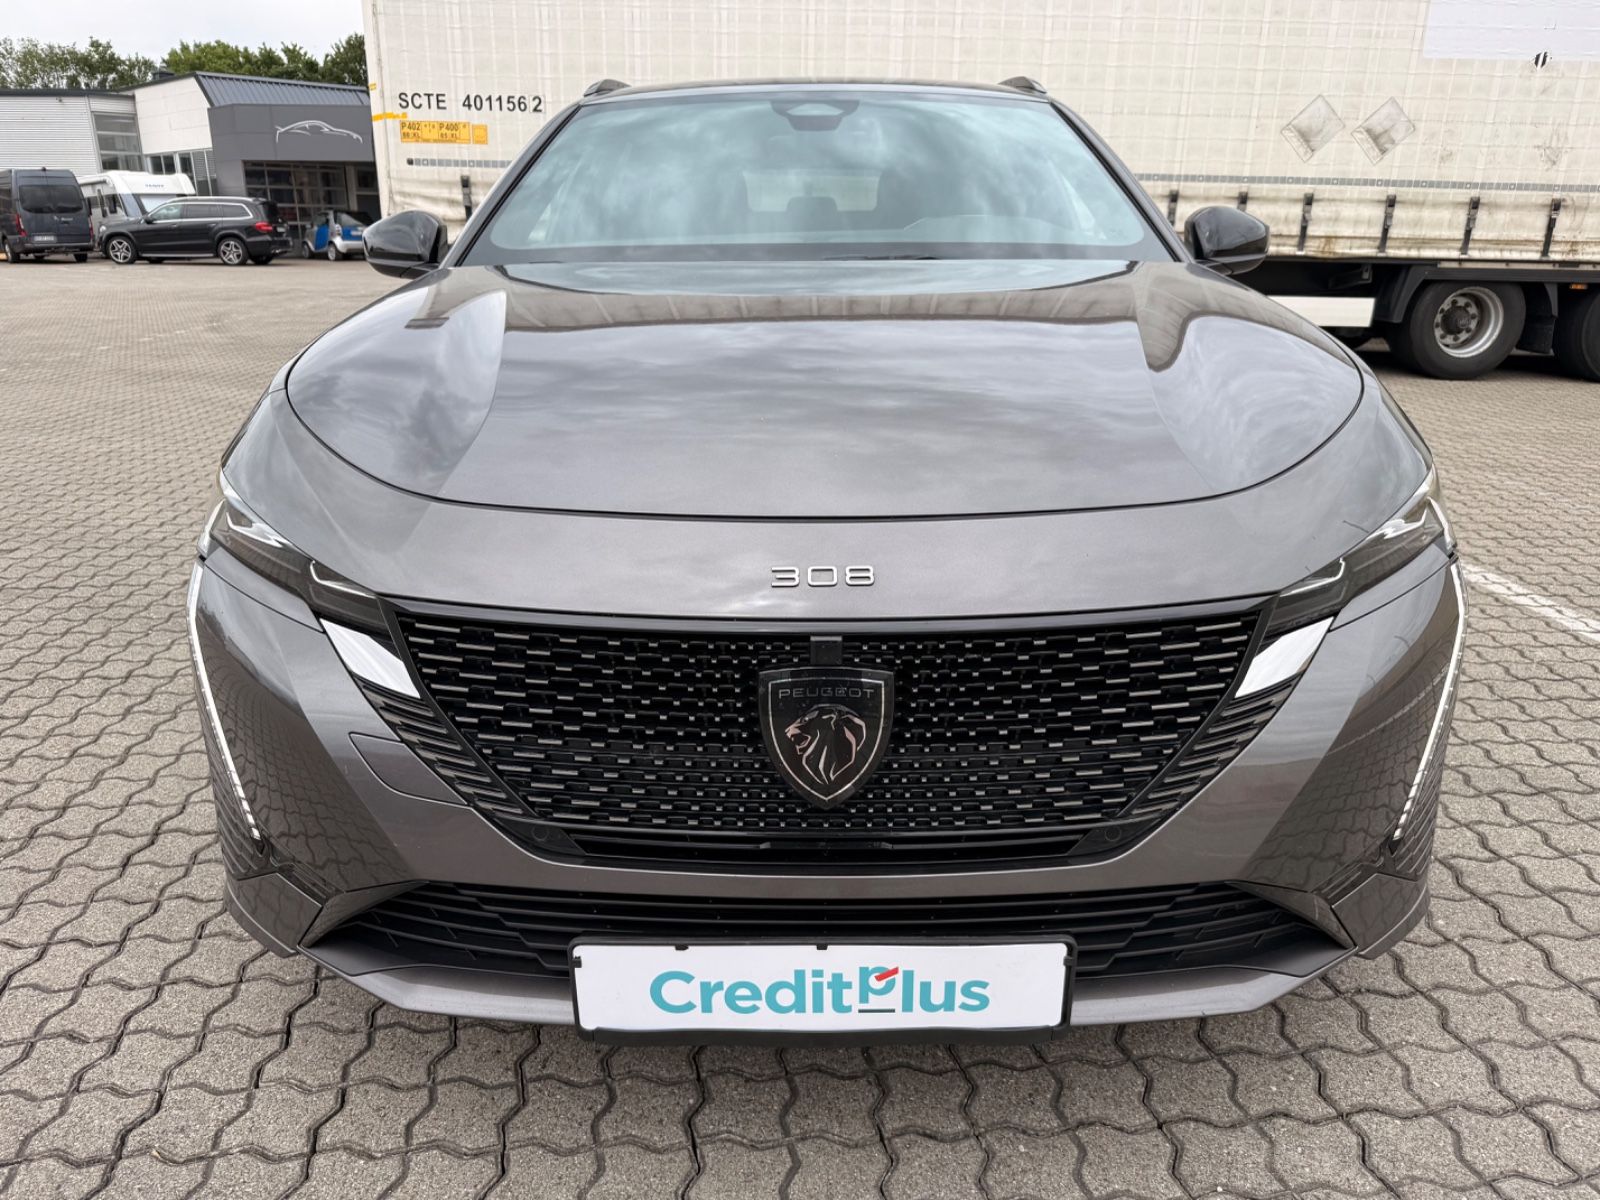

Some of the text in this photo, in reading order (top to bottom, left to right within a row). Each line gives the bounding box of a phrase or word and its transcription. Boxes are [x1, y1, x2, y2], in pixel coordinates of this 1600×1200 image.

[398, 92, 447, 110] SCTE
[771, 565, 875, 588] 308
[778, 687, 875, 700] PEUGEOT
